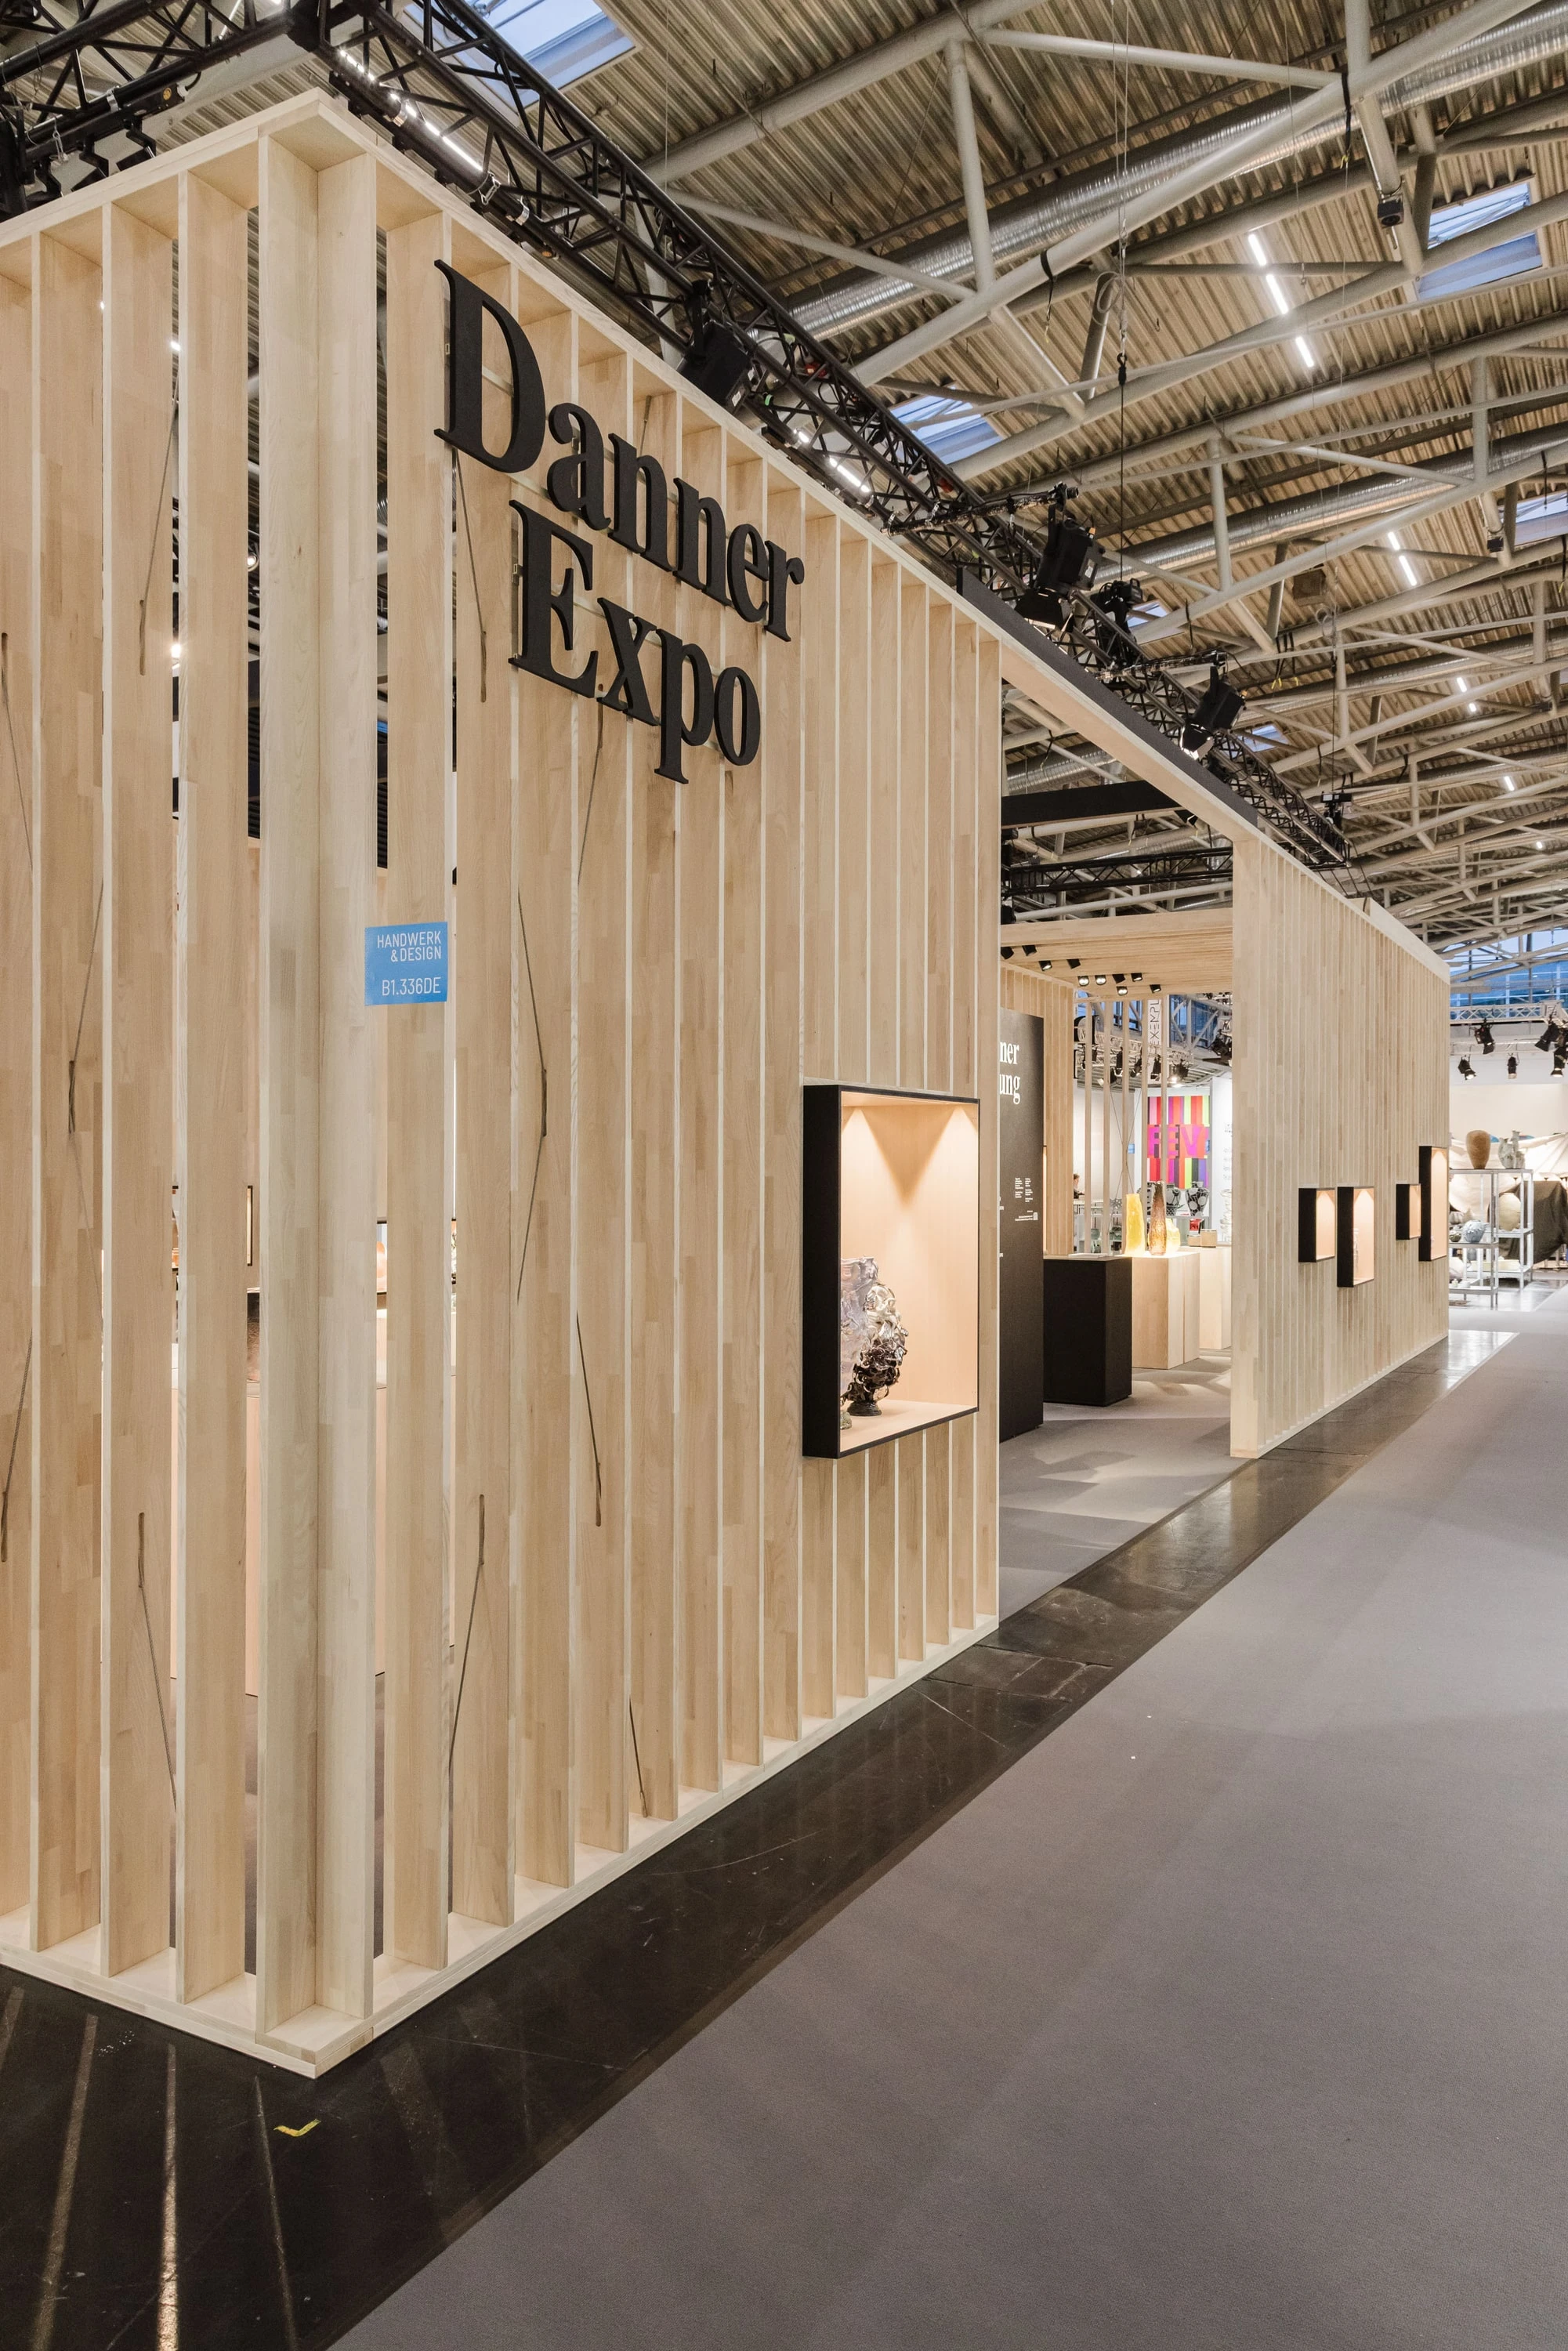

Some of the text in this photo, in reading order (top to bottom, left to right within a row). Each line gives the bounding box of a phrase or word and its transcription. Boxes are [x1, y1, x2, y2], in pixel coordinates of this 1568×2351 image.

[434, 259, 805, 642] Danner
[509, 500, 760, 784] Expo
[377, 930, 441, 948] HANDWERK
[382, 976, 441, 996] B1.336DE
